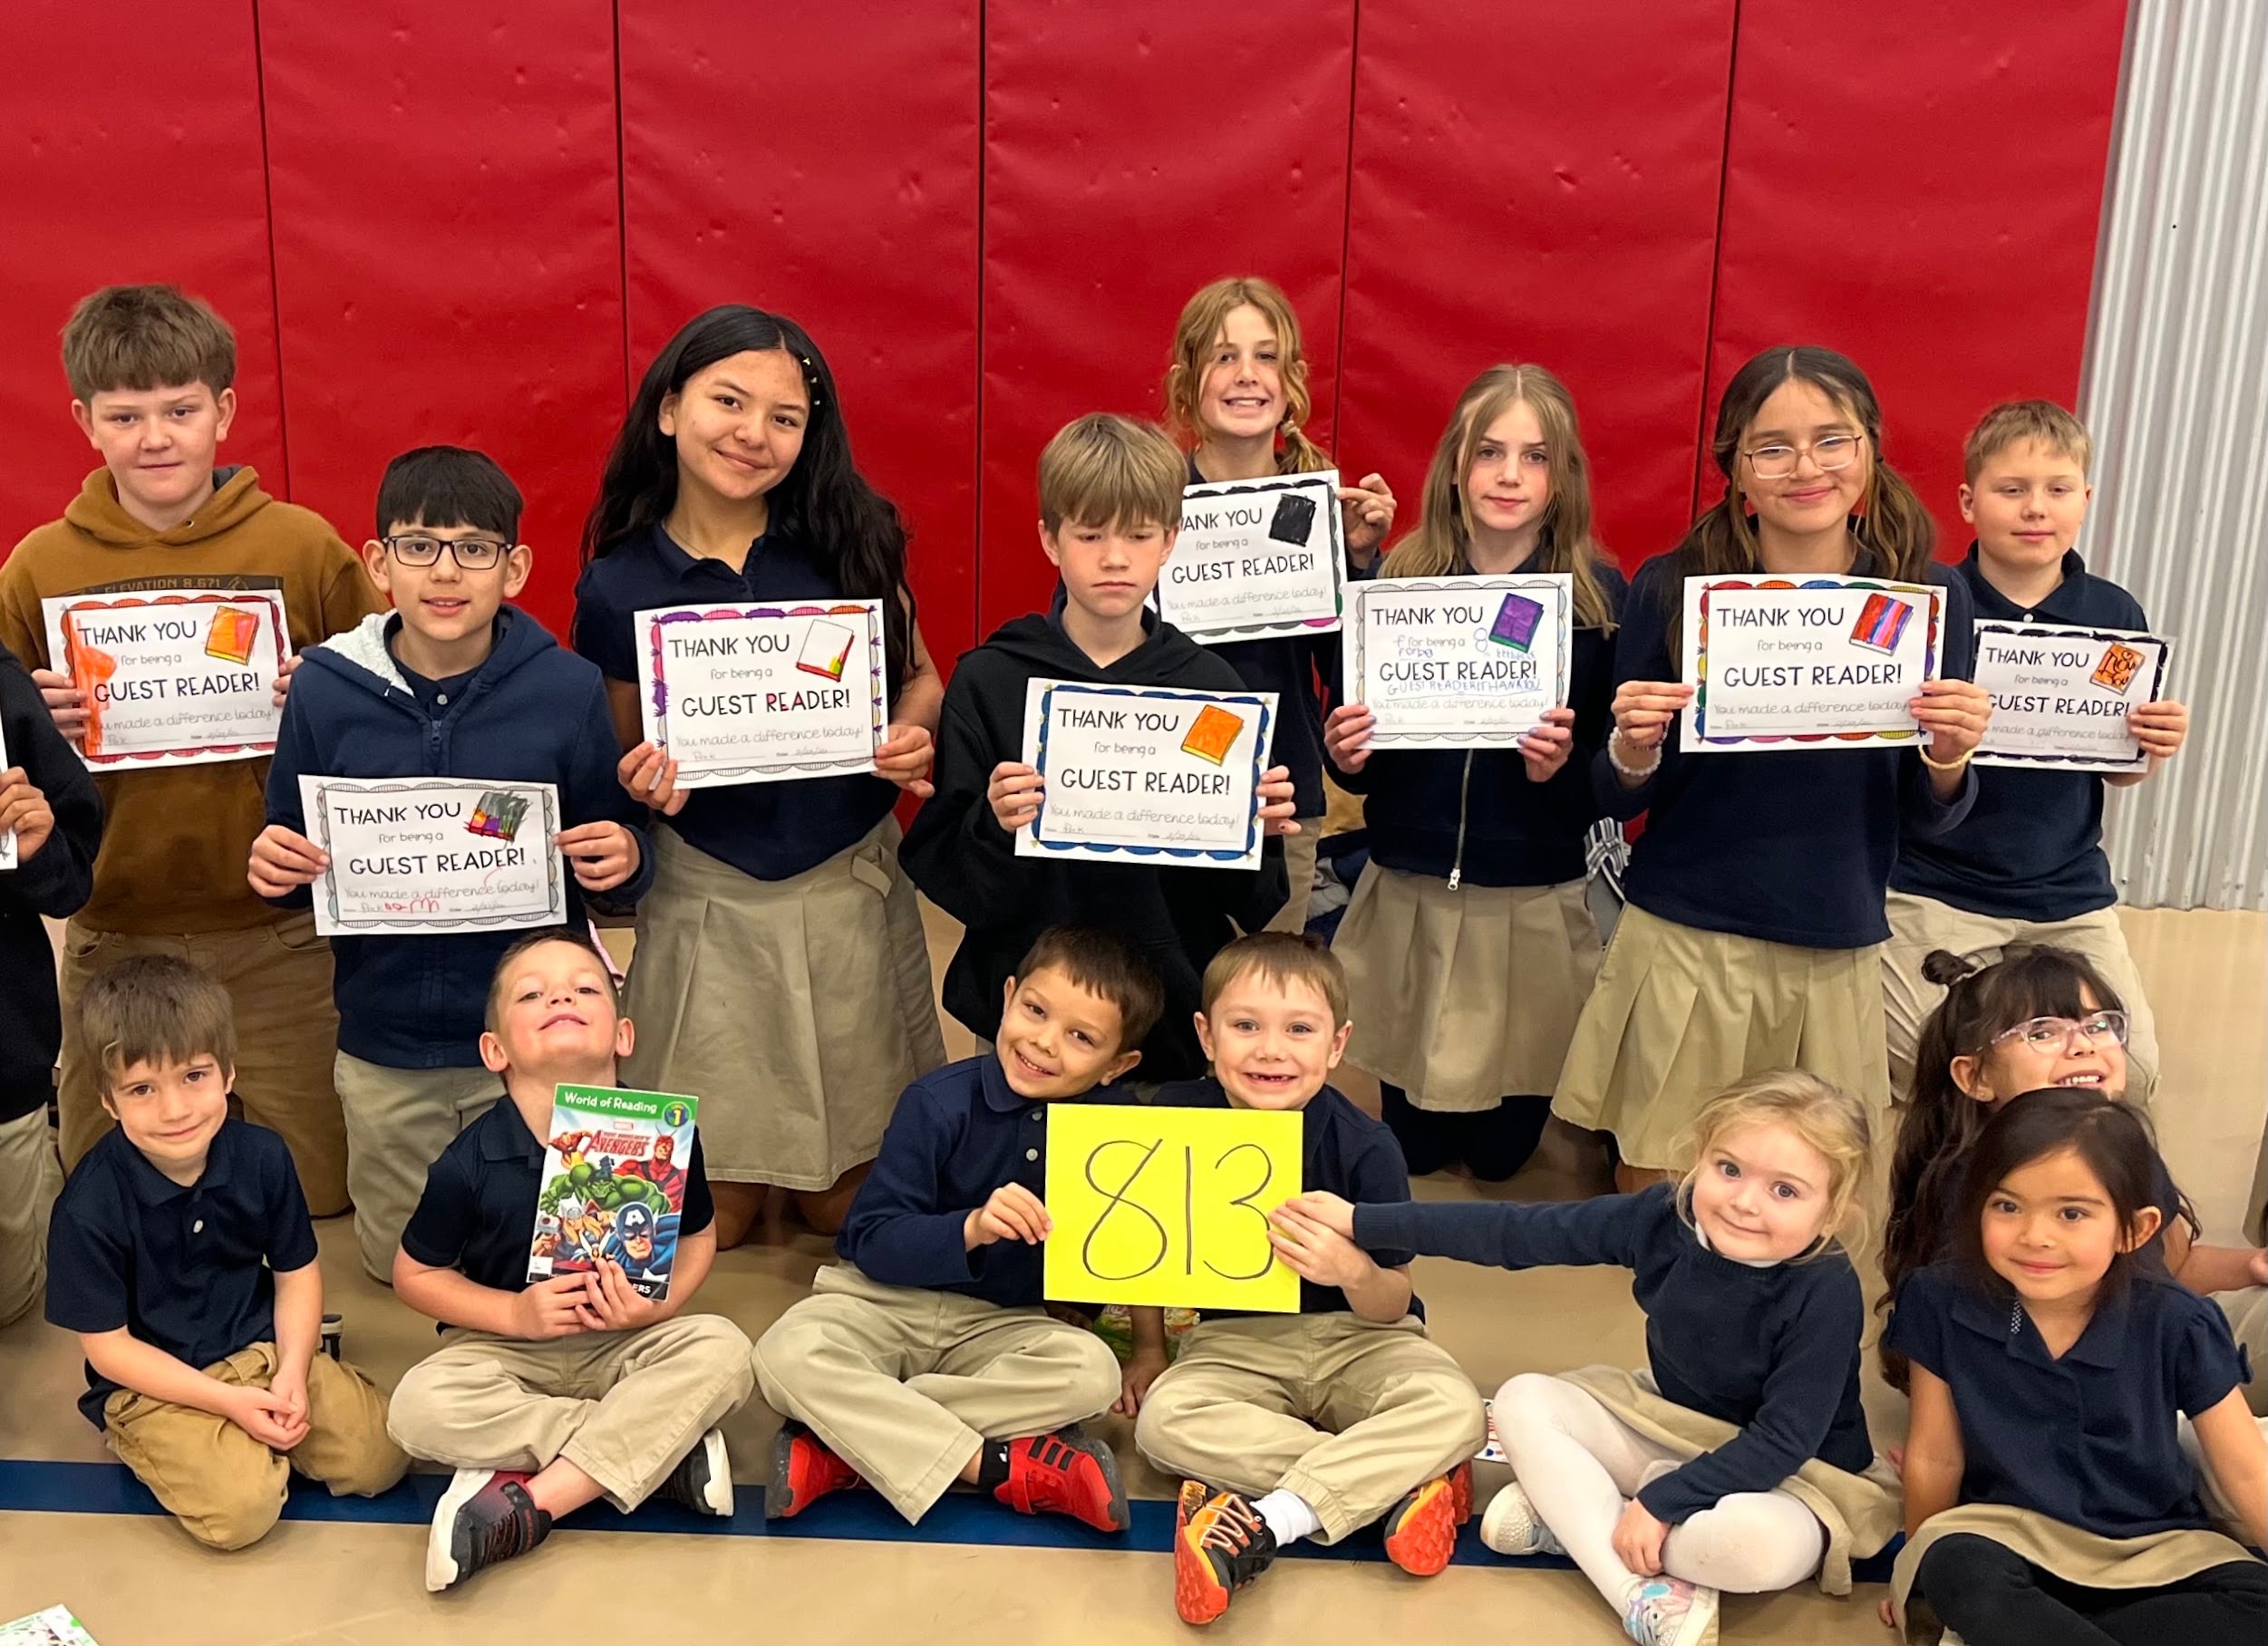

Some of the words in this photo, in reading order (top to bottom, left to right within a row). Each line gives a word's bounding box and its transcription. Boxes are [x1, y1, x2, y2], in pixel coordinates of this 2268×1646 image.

[1181, 512, 1220, 531] ANK
[1225, 508, 1263, 528] YOU
[1196, 540, 1211, 550] for
[1213, 538, 1241, 550] being
[1241, 538, 1248, 547] a
[1172, 561, 1236, 585] GUEST
[1242, 553, 1314, 576] READER!
[1167, 601, 1186, 610] You
[1187, 598, 1220, 609] made
[1233, 591, 1289, 605] difference
[1371, 607, 1436, 625] THANK
[1443, 606, 1483, 624] YOU
[1717, 608, 1790, 627] THANK
[1798, 607, 1844, 626] YOU
[78, 625, 146, 645] THANK
[154, 621, 197, 640] YOU
[668, 637, 739, 658] THANK
[745, 634, 790, 654] YOU
[1408, 636, 1423, 647] for
[1427, 636, 1456, 650] being
[1458, 638, 1466, 646] a
[1758, 639, 1775, 651] for
[1778, 639, 1812, 653] being
[1815, 641, 1823, 651] a
[121, 655, 137, 666] for
[141, 654, 172, 665] being
[174, 654, 182, 663] a
[1985, 646, 2046, 665] THANK
[2051, 652, 2090, 668] YOU
[711, 668, 728, 680] for
[731, 666, 763, 680] being
[765, 668, 773, 677] a
[1380, 662, 1449, 681] GUEST
[1458, 660, 1536, 680] READER!
[1724, 666, 1804, 687] GUEST
[1813, 663, 1902, 686] READER!
[94, 680, 167, 702] GUEST
[177, 673, 260, 697] READER!
[2014, 675, 2030, 685] for
[2031, 676, 2060, 687] being
[682, 693, 757, 717] GUEST
[766, 689, 850, 712] READER!
[1371, 700, 1391, 709] You
[1392, 700, 1428, 709] made
[1430, 701, 1439, 709] a
[1443, 698, 1505, 709] difference
[1714, 703, 1735, 714] You
[1739, 704, 1778, 714] made
[1781, 705, 1791, 714] a
[1795, 702, 1867, 714] difference
[1868, 700, 1907, 712] today
[2055, 698, 2130, 717] READER!
[114, 717, 151, 729] made
[153, 718, 162, 726] a
[167, 711, 233, 725] difference
[1058, 708, 1128, 731] THANK
[1135, 712, 1179, 732] YOU
[675, 735, 698, 747] You
[700, 733, 739, 746] made
[741, 735, 750, 743] a
[753, 728, 819, 742] difference
[1992, 725, 2025, 735] made
[2027, 727, 2034, 735] a
[2036, 726, 2096, 738] difference
[2098, 730, 2130, 742] today
[1094, 741, 1111, 754] for
[1114, 742, 1146, 757] being
[1149, 746, 1156, 756] a
[1061, 768, 1138, 792] GUEST
[1145, 771, 1230, 796] READER!
[334, 806, 407, 825] THANK
[415, 802, 460, 819] YOU
[1050, 803, 1071, 818] You
[1073, 808, 1113, 821] made
[1114, 811, 1123, 820] a
[1126, 808, 1198, 826] difference
[379, 833, 396, 844] for
[400, 832, 433, 843] being
[436, 832, 444, 841] a
[349, 856, 428, 875] GUEST
[437, 847, 525, 873] READER!
[344, 887, 368, 899] You
[369, 887, 408, 899] made
[412, 890, 421, 898] a
[426, 885, 494, 899] difference
[565, 1091, 596, 1108] World
[600, 1096, 612, 1108] of
[614, 1097, 657, 1114] Reading
[674, 1109, 681, 1126] 1
[583, 1129, 650, 1157] AVENGERS
[1082, 1138, 1275, 1281] 813
